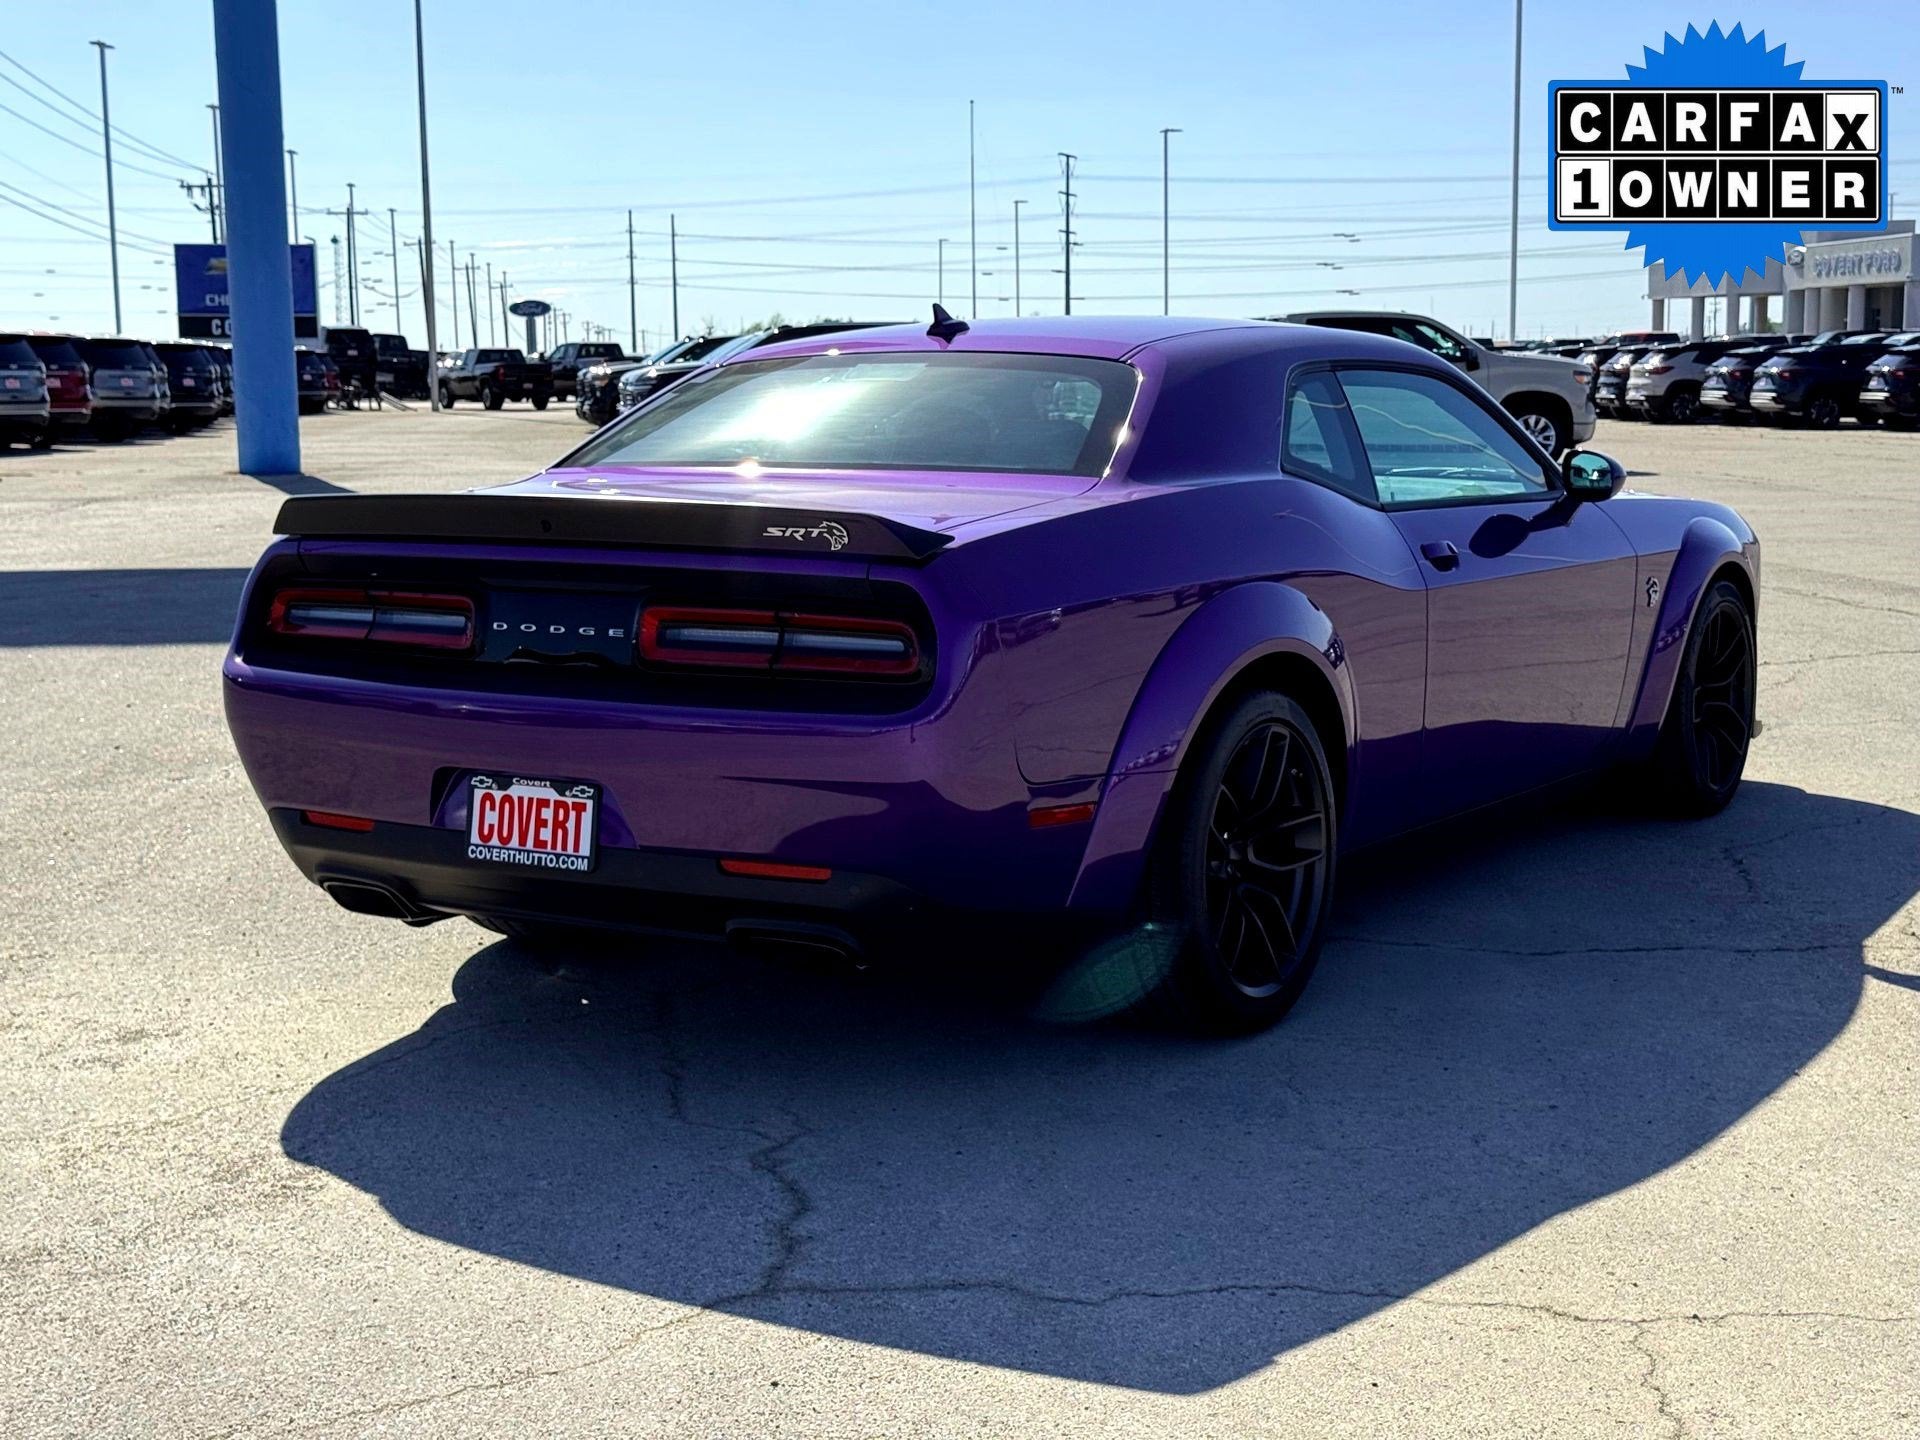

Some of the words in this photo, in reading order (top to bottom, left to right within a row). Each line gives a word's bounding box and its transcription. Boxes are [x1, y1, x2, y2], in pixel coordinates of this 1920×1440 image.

[1814, 253, 1863, 278] COVERT
[1865, 248, 1903, 274] FORD
[763, 527, 827, 541] SRT
[492, 621, 625, 638] DODGE
[512, 777, 551, 788] Covert
[477, 791, 587, 854] COVERT
[468, 845, 588, 871] COVERTHUTTO.COM
